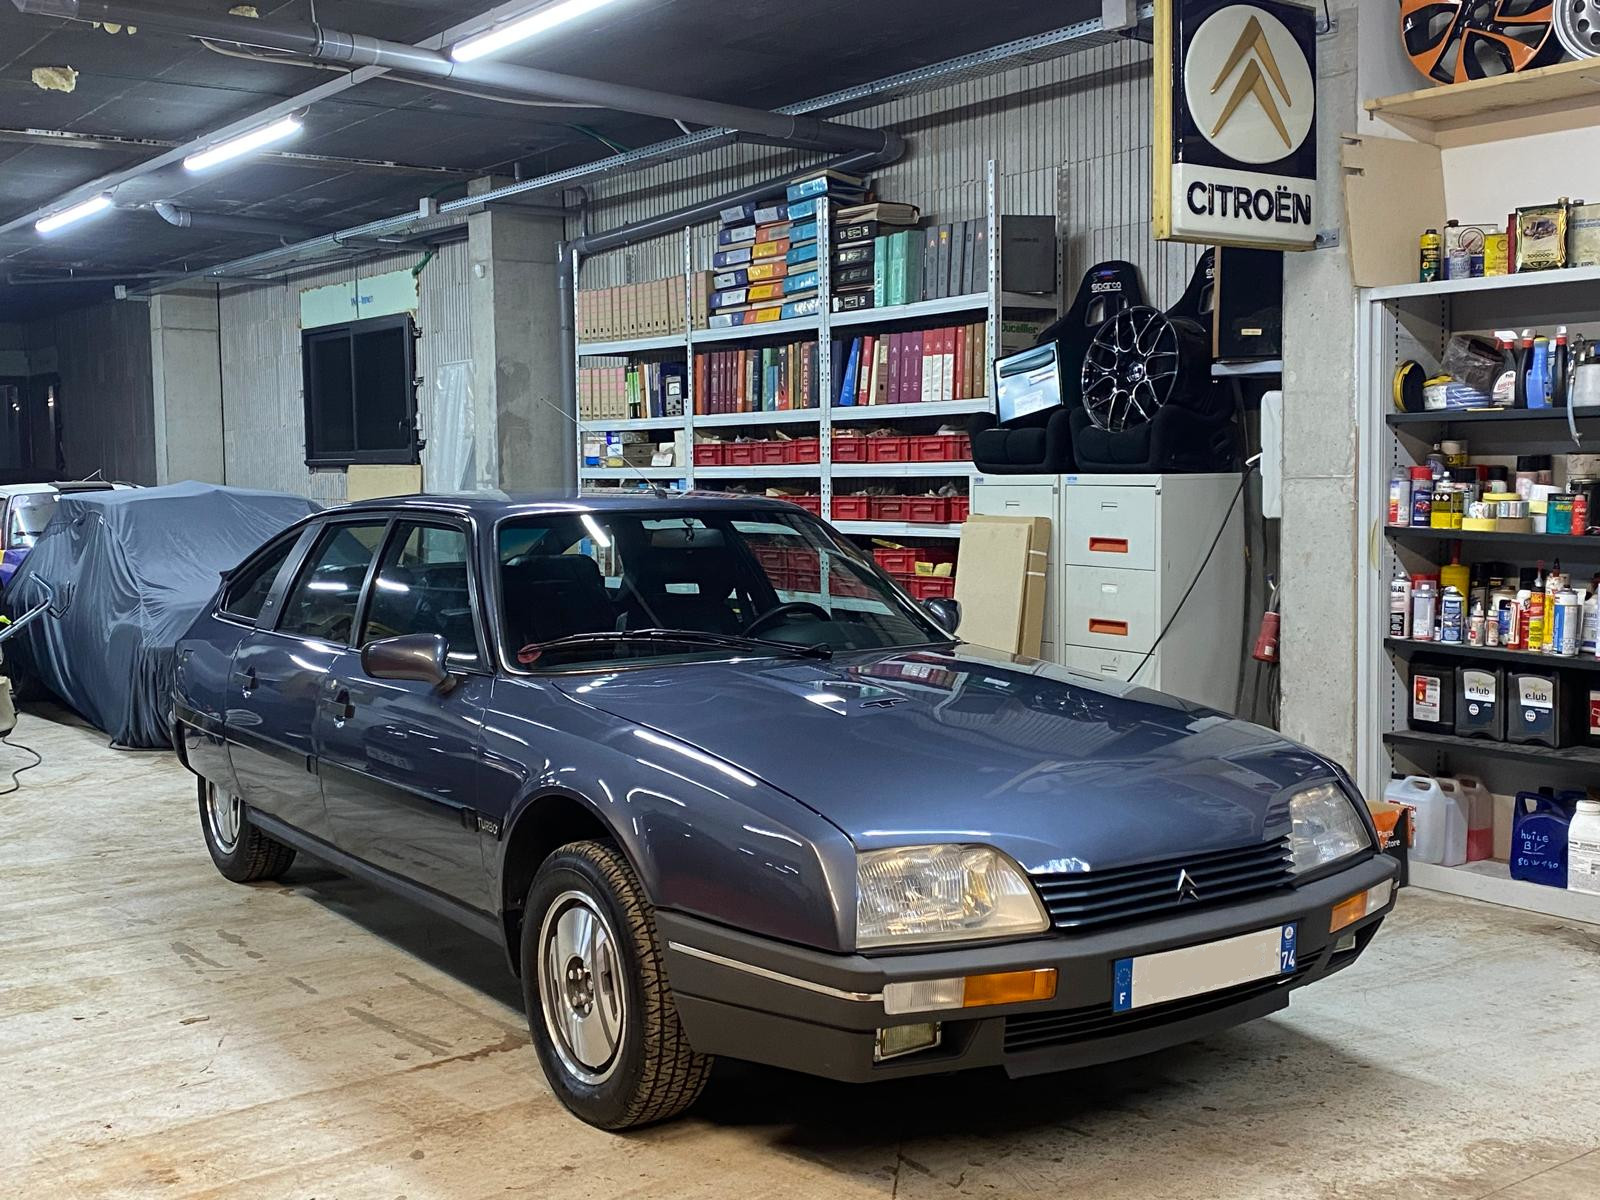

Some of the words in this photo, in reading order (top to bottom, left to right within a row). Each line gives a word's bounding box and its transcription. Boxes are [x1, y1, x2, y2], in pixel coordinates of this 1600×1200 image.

[1187, 181, 1311, 225] CITROËN
[1091, 282, 1122, 293] sparco
[1281, 949, 1296, 969] 74
[1119, 992, 1126, 1005] F
